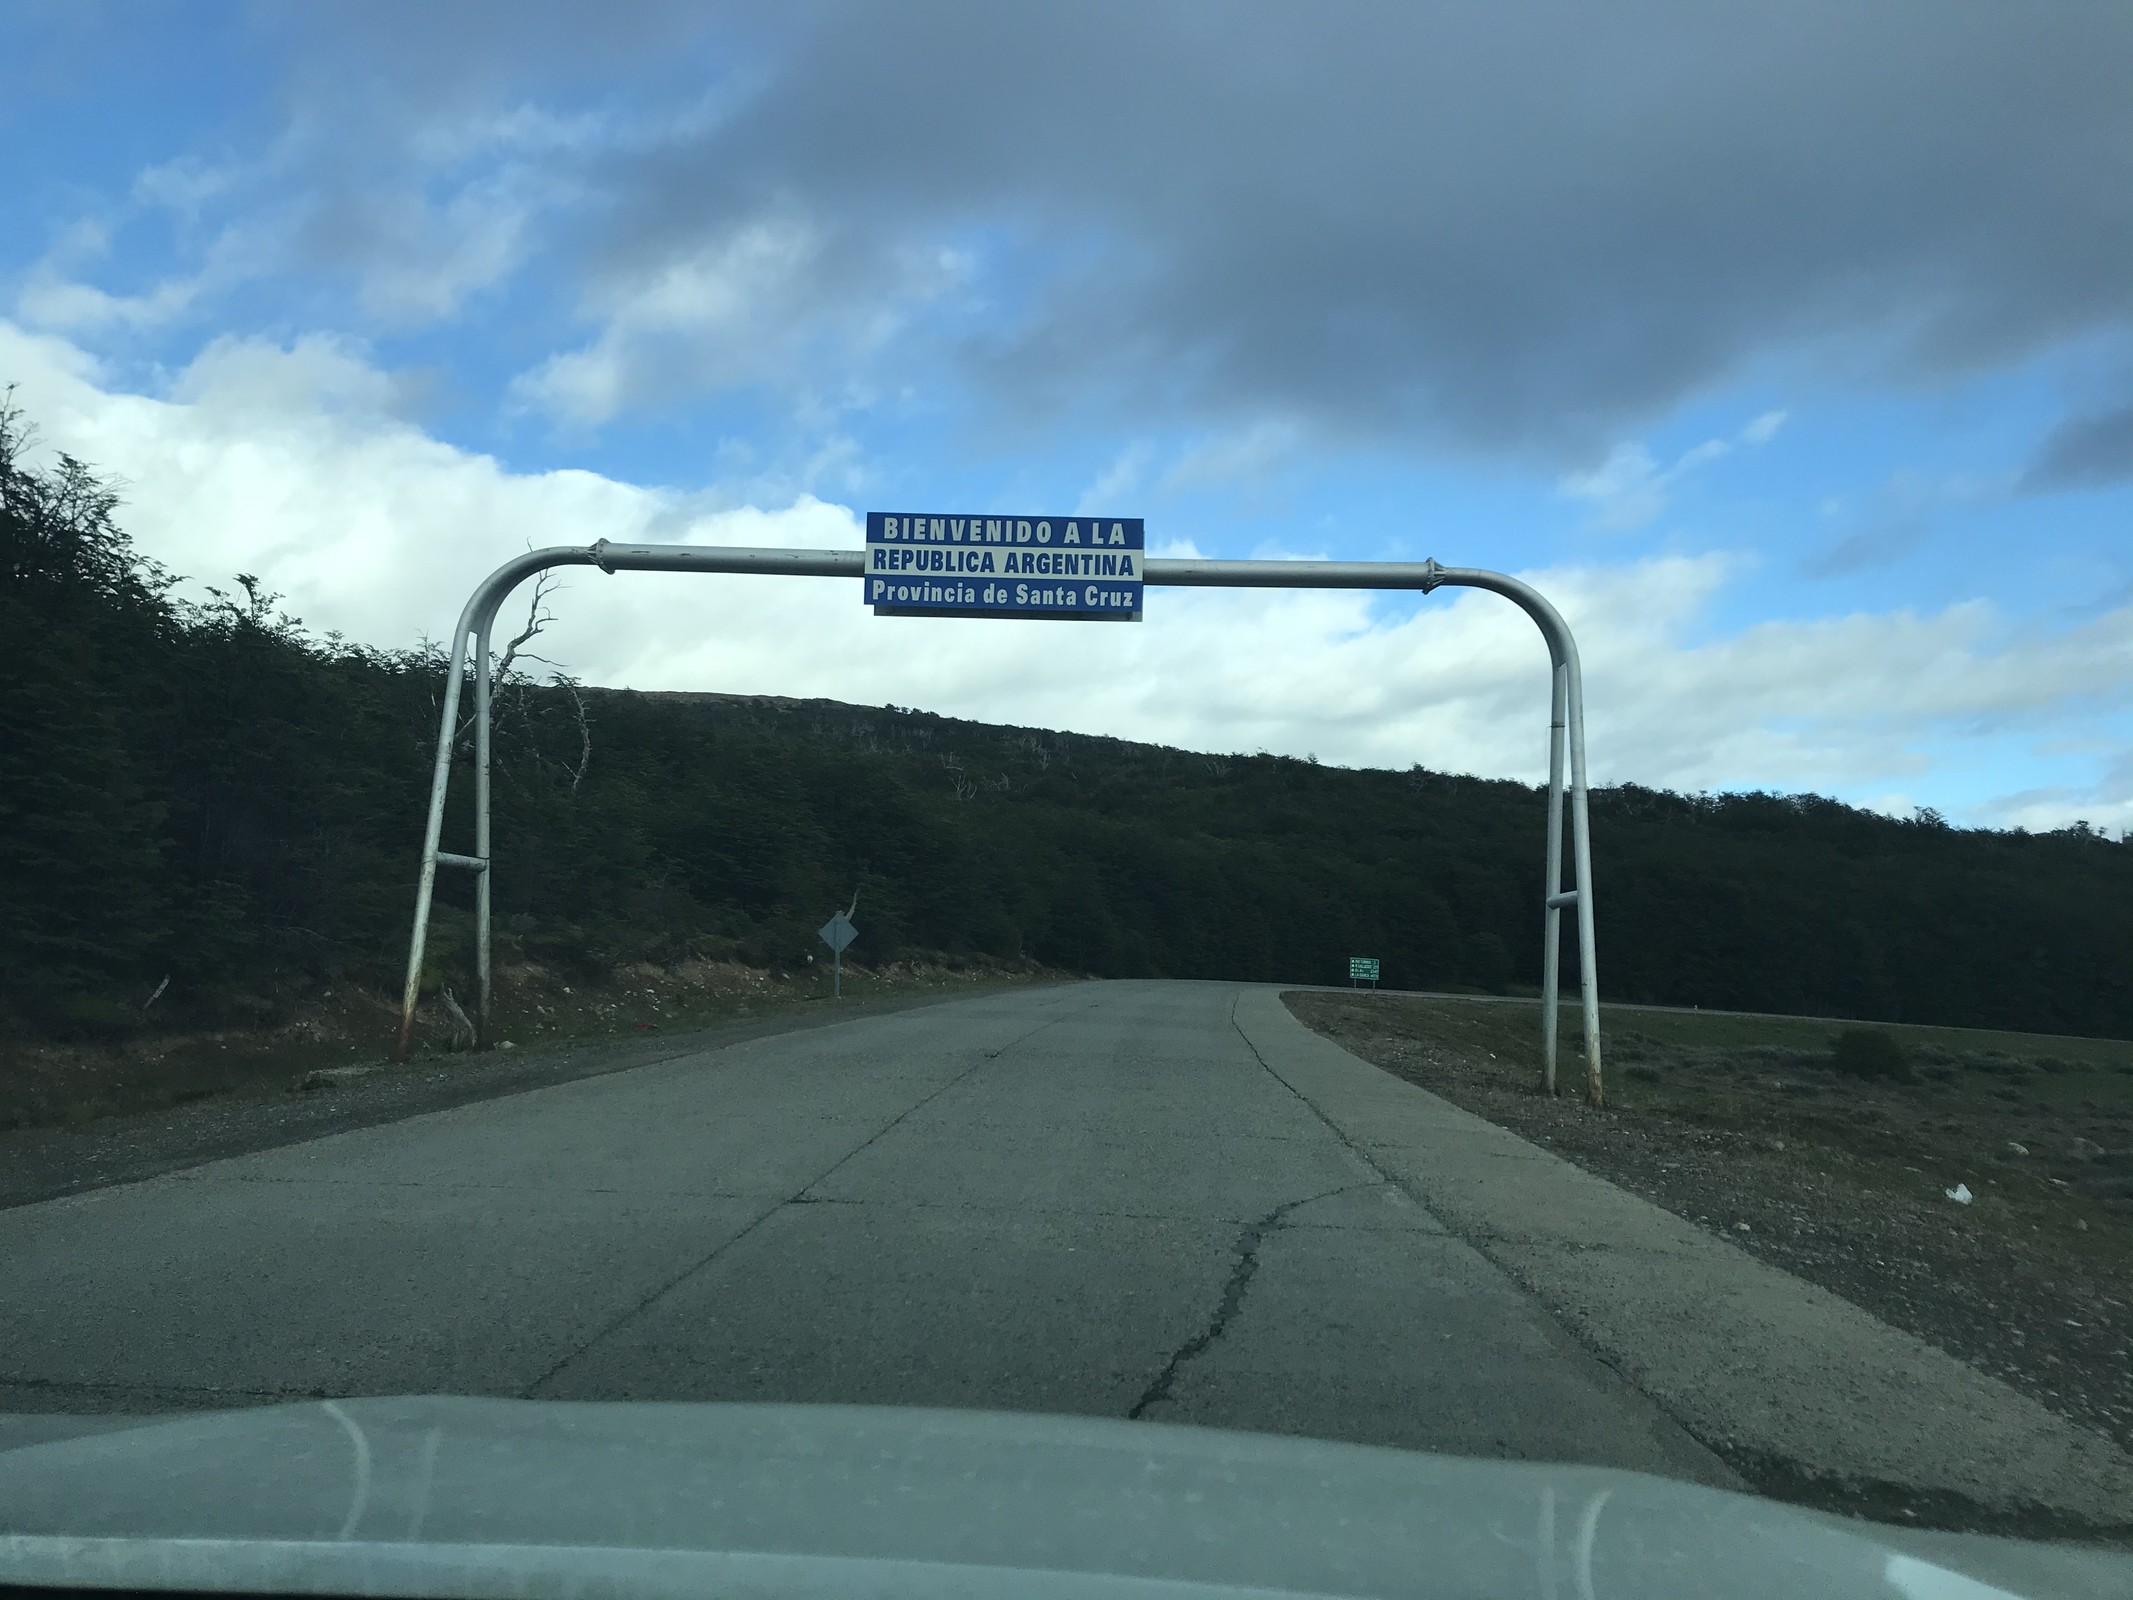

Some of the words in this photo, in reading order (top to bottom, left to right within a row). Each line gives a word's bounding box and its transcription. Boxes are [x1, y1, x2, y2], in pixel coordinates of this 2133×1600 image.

[884, 517, 1052, 544] BIENVENIDO
[1063, 521, 1081, 544] A
[1092, 522, 1126, 545] LA
[873, 548, 995, 573] REPUBLICA
[1004, 552, 1134, 576] ARGENTINA
[872, 580, 975, 603] Provincia
[983, 583, 1008, 604] de
[1016, 584, 1077, 606] Santa
[1085, 585, 1133, 607] Cruz
